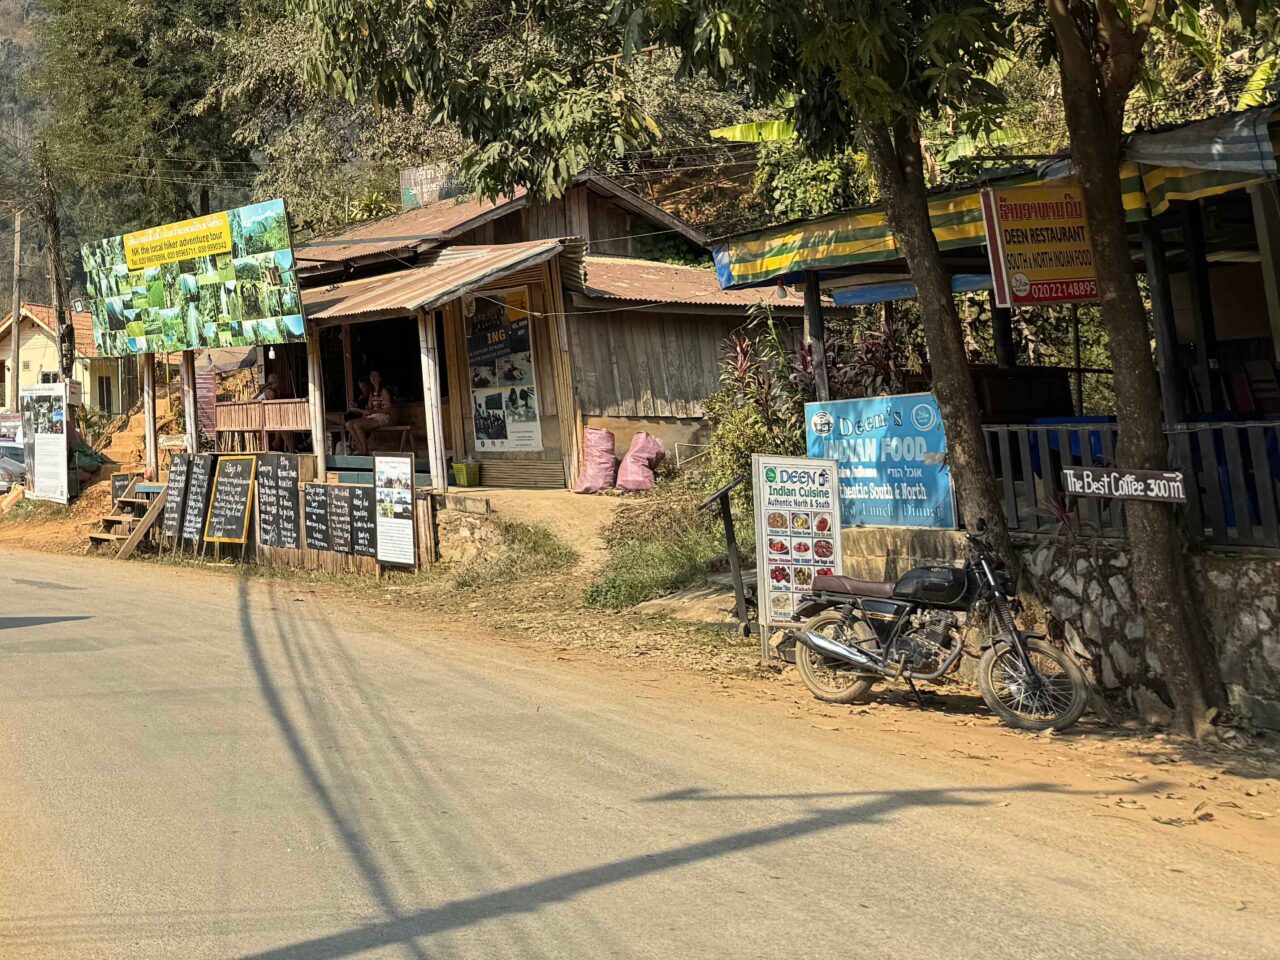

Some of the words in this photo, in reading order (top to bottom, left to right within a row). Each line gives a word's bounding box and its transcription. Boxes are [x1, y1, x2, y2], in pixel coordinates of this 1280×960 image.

[131, 248, 140, 256] NK
[140, 245, 150, 256] the
[150, 242, 164, 253] local
[163, 239, 178, 250] hiker
[179, 233, 210, 247] adventure
[210, 231, 223, 241] tour
[1004, 228, 1029, 245] DEEN
[1030, 226, 1086, 244] RESTAURANT
[1007, 253, 1028, 270] SOUTH
[1032, 251, 1053, 269] NORTH
[1053, 250, 1075, 268] INDIAN
[1075, 249, 1092, 266] FOOD
[838, 405, 903, 437] Deen's
[823, 438, 877, 462] INDIAN
[881, 436, 928, 462] FOOD
[780, 469, 817, 487] DEEN
[887, 467, 903, 478] הודי
[904, 465, 923, 478] אוכל
[768, 486, 796, 497] Indian
[799, 487, 830, 498] Cuisine
[869, 483, 894, 499] South
[894, 484, 901, 499] &
[901, 483, 927, 500] North
[1063, 469, 1083, 493] The
[1083, 471, 1110, 494] Best
[1111, 472, 1144, 497] Coffee
[1146, 479, 1168, 497] 300
[768, 498, 793, 507] Authentic
[793, 499, 808, 508] North
[815, 499, 830, 508] South
[862, 502, 894, 517] Lunch
[902, 503, 943, 517] Dinner
